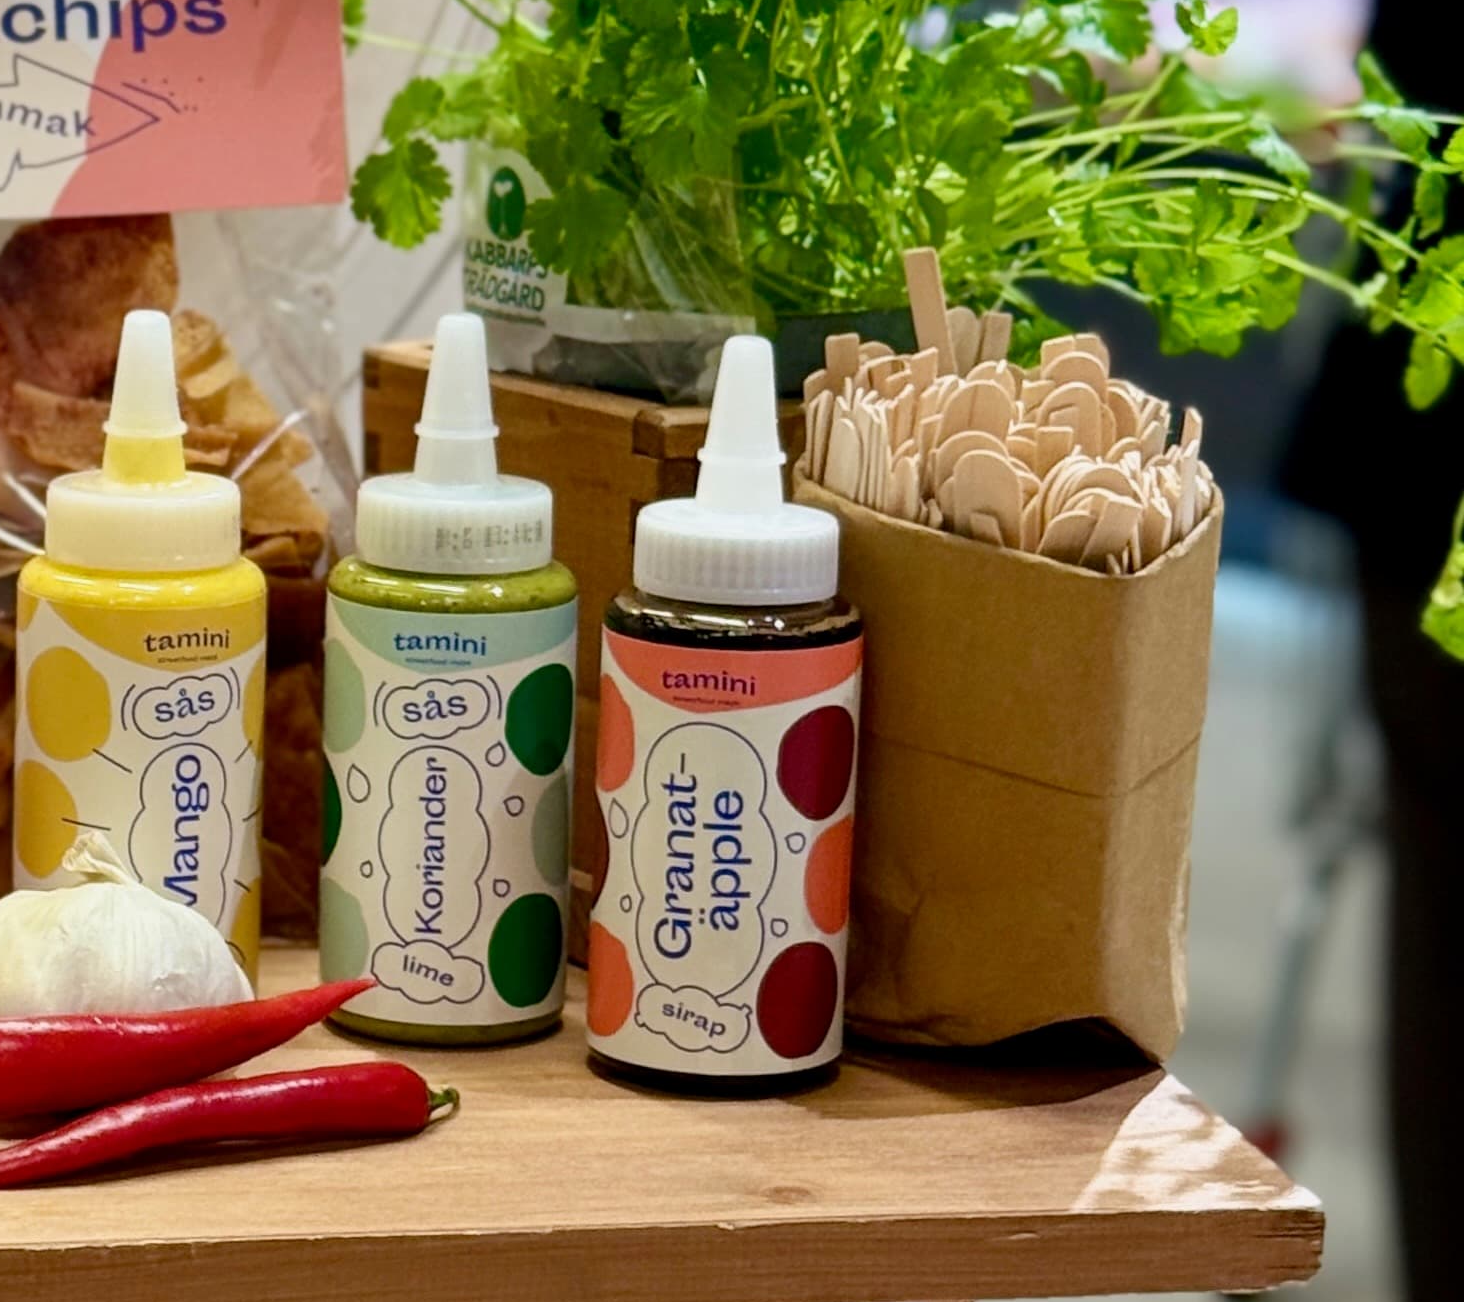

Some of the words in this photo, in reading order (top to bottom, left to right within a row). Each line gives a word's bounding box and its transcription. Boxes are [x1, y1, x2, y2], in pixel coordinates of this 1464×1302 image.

[143, 627, 231, 652] tamini
[393, 631, 487, 656] tamini
[661, 670, 756, 696] tamini
[154, 688, 216, 723] sås
[402, 690, 469, 723] sås
[413, 756, 448, 936] Koriander
[653, 751, 700, 960] Granat-
[698, 789, 753, 931] äpple
[401, 953, 455, 988] lime
[661, 999, 727, 1039] sirap
